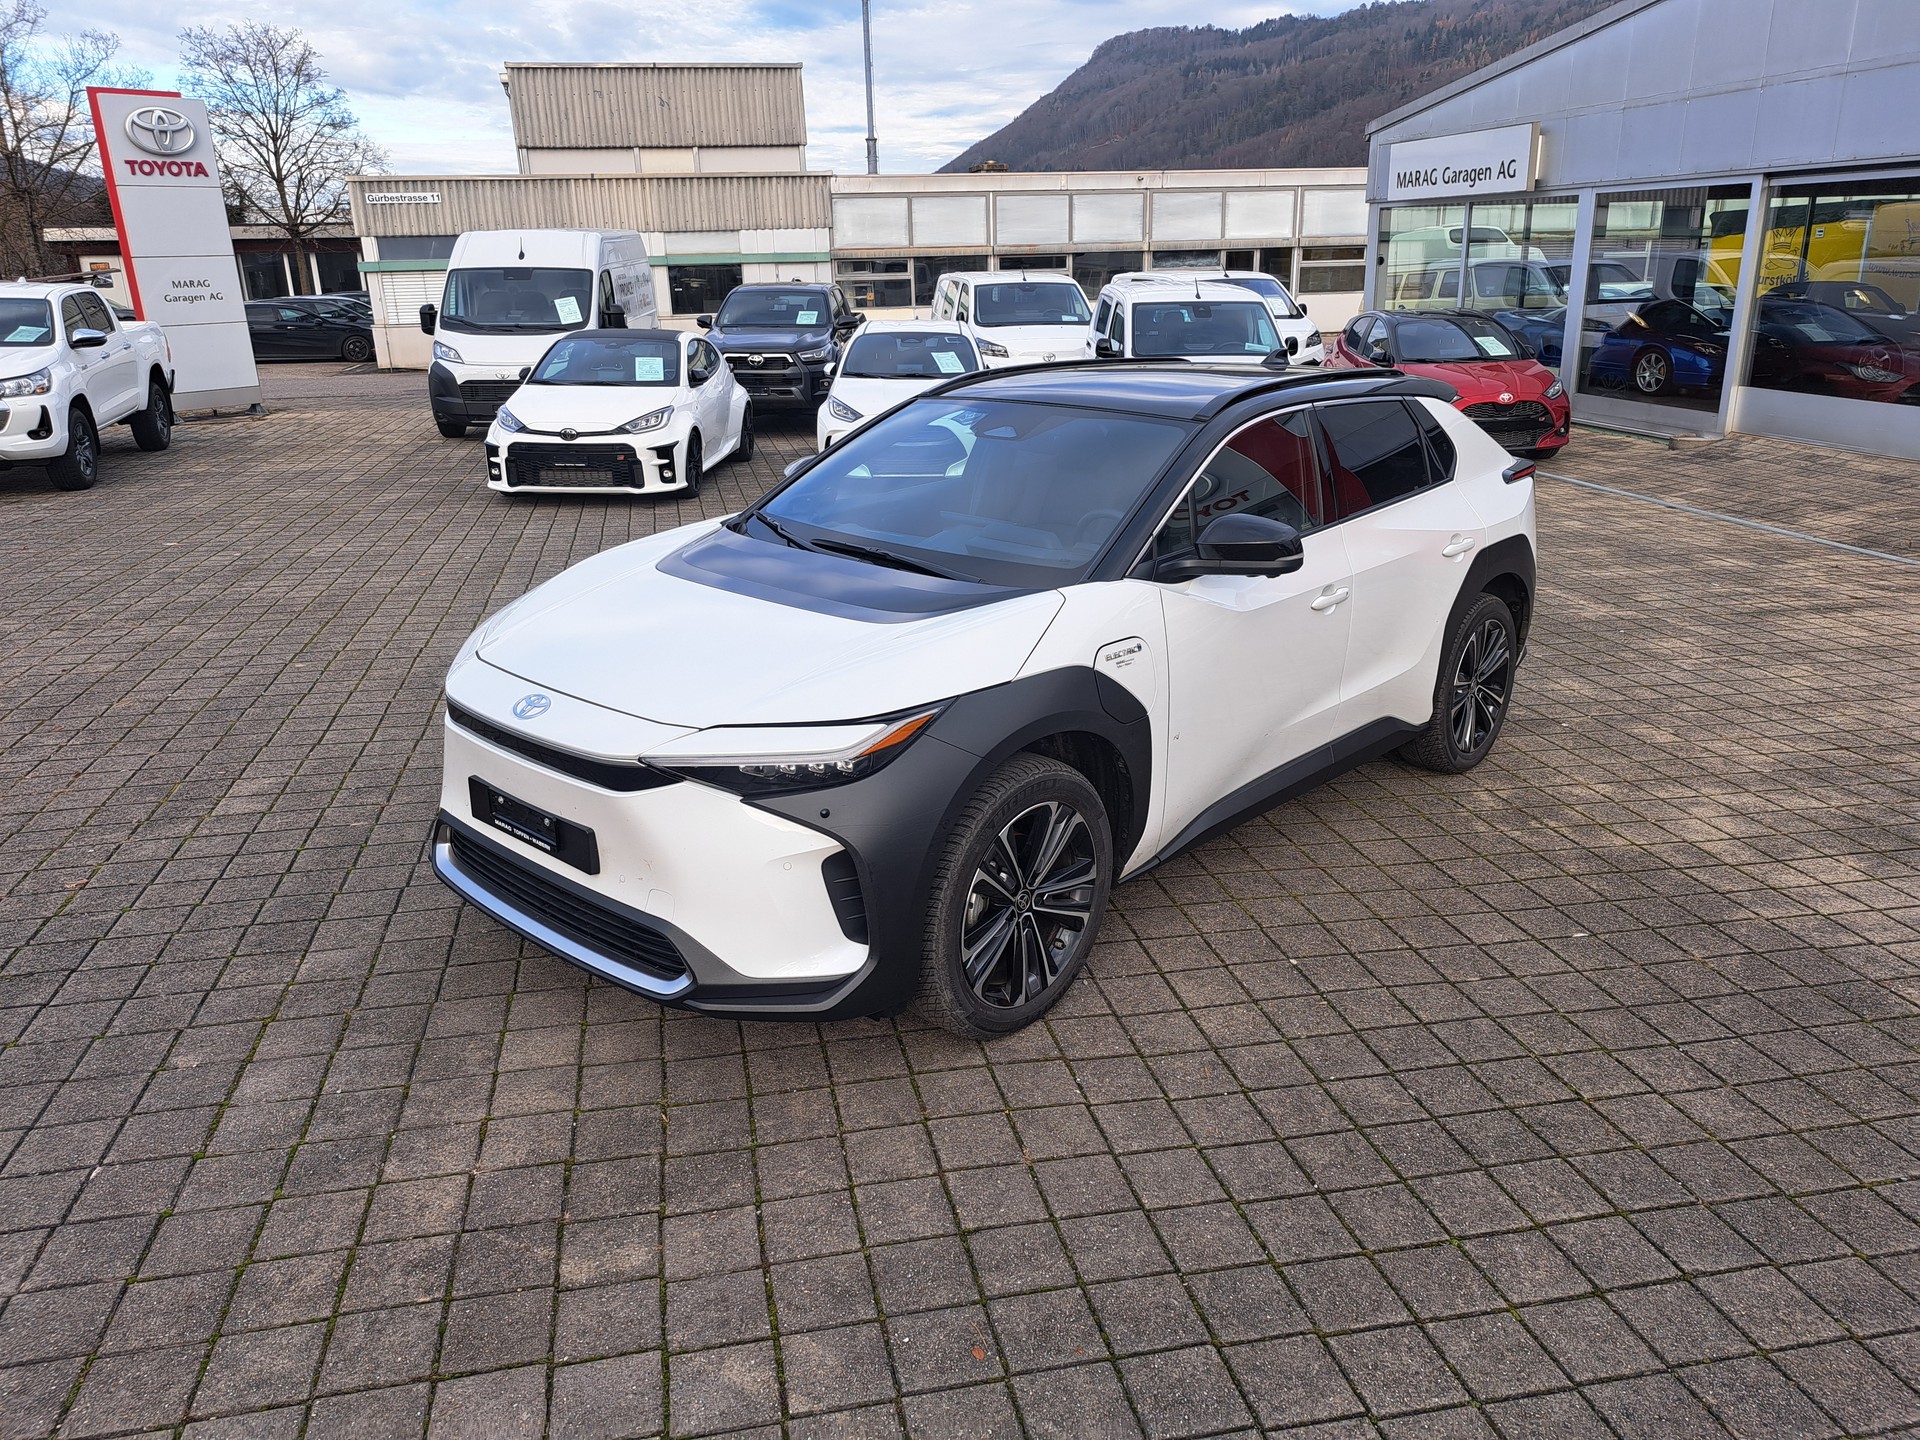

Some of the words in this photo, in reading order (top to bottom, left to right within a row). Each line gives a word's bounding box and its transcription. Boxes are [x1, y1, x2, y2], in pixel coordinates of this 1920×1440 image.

[124, 159, 209, 177] TOYOTA
[1396, 168, 1438, 189] MARAG
[1442, 166, 1492, 188] Garagen
[1496, 159, 1517, 180] AG
[367, 194, 428, 202] Gürbestrasse
[431, 194, 441, 202] 11
[1868, 262, 1919, 279] www.wurs
[171, 279, 211, 289] MARAG
[1759, 271, 1810, 286] urstköng
[164, 294, 206, 304] Garagen
[210, 292, 224, 301] AG
[494, 819, 512, 832] MARAG
